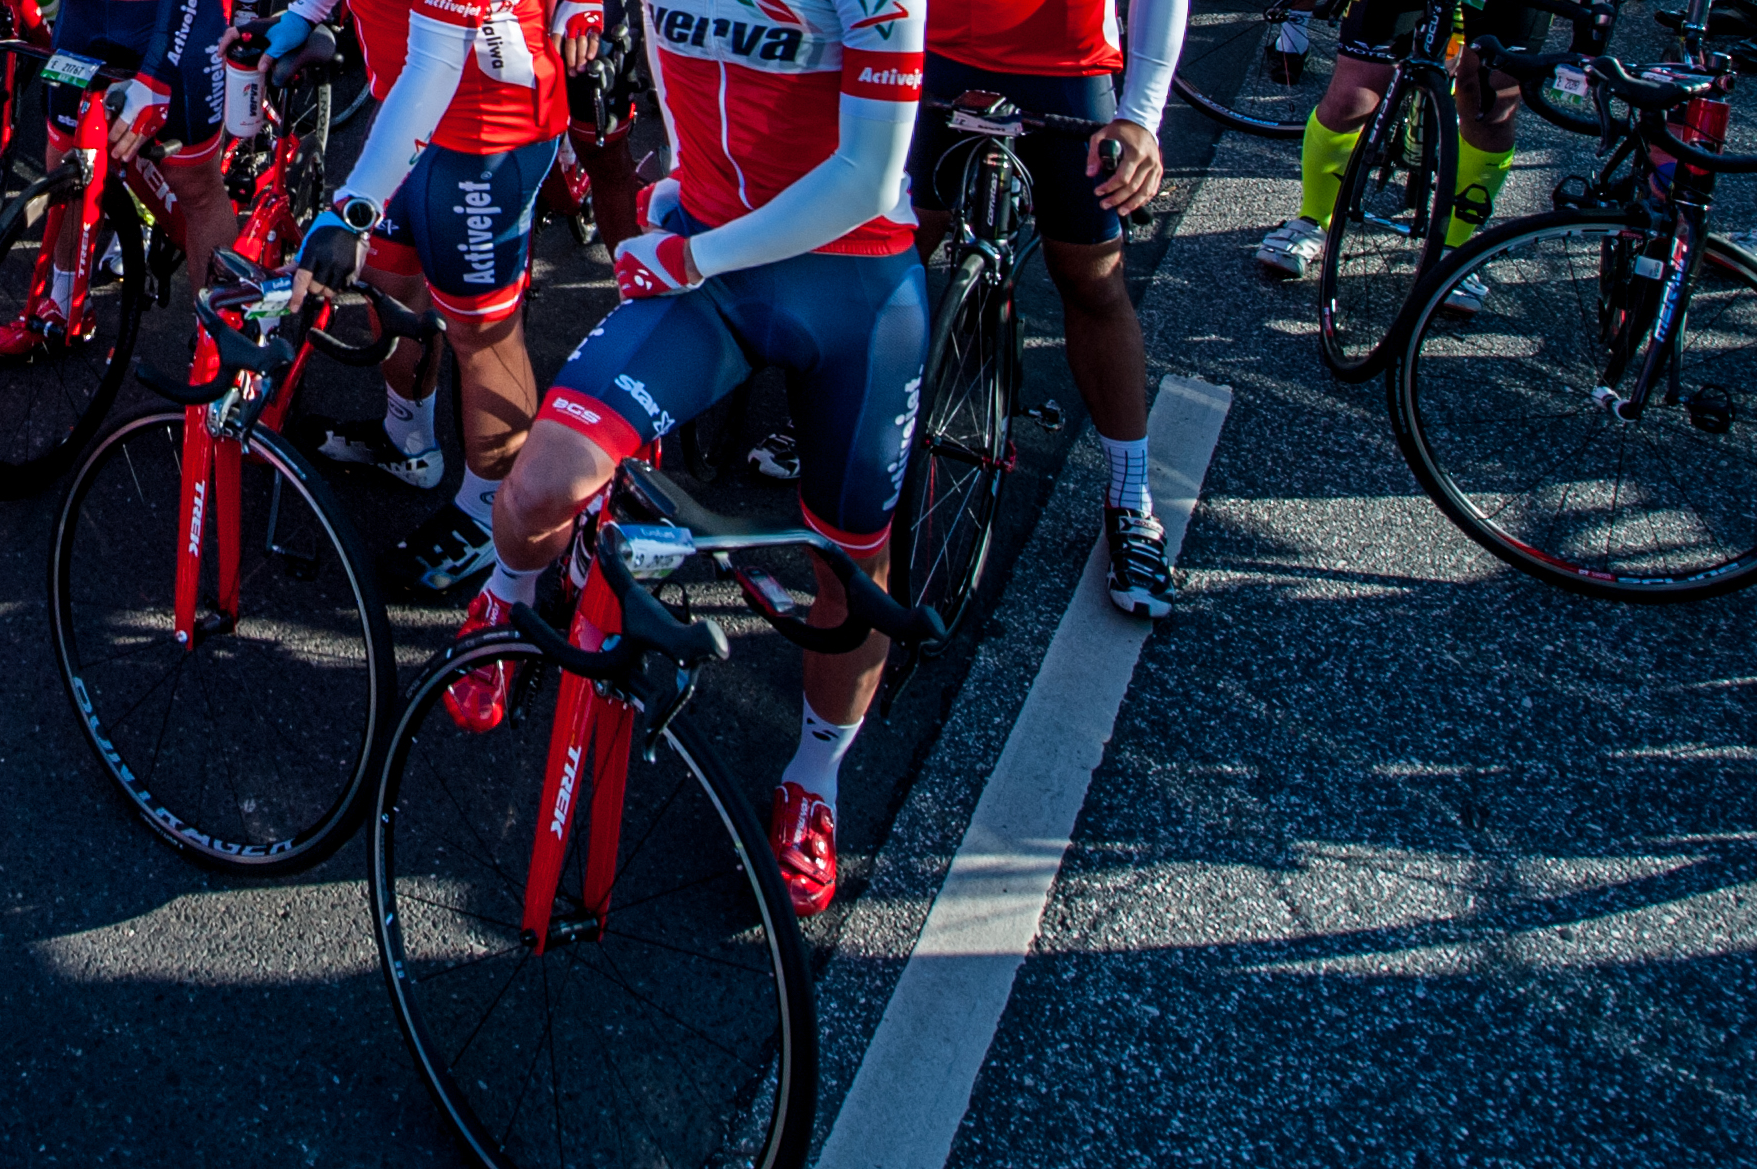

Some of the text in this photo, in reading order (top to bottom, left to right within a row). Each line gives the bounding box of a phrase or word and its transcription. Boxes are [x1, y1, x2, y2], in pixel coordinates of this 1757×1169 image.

[647, 3, 804, 63] verva
[453, 179, 504, 285] Activejet
[551, 396, 602, 425] BGS
[614, 373, 661, 418] star
[188, 479, 207, 559] TREK
[548, 744, 582, 841] TREK
